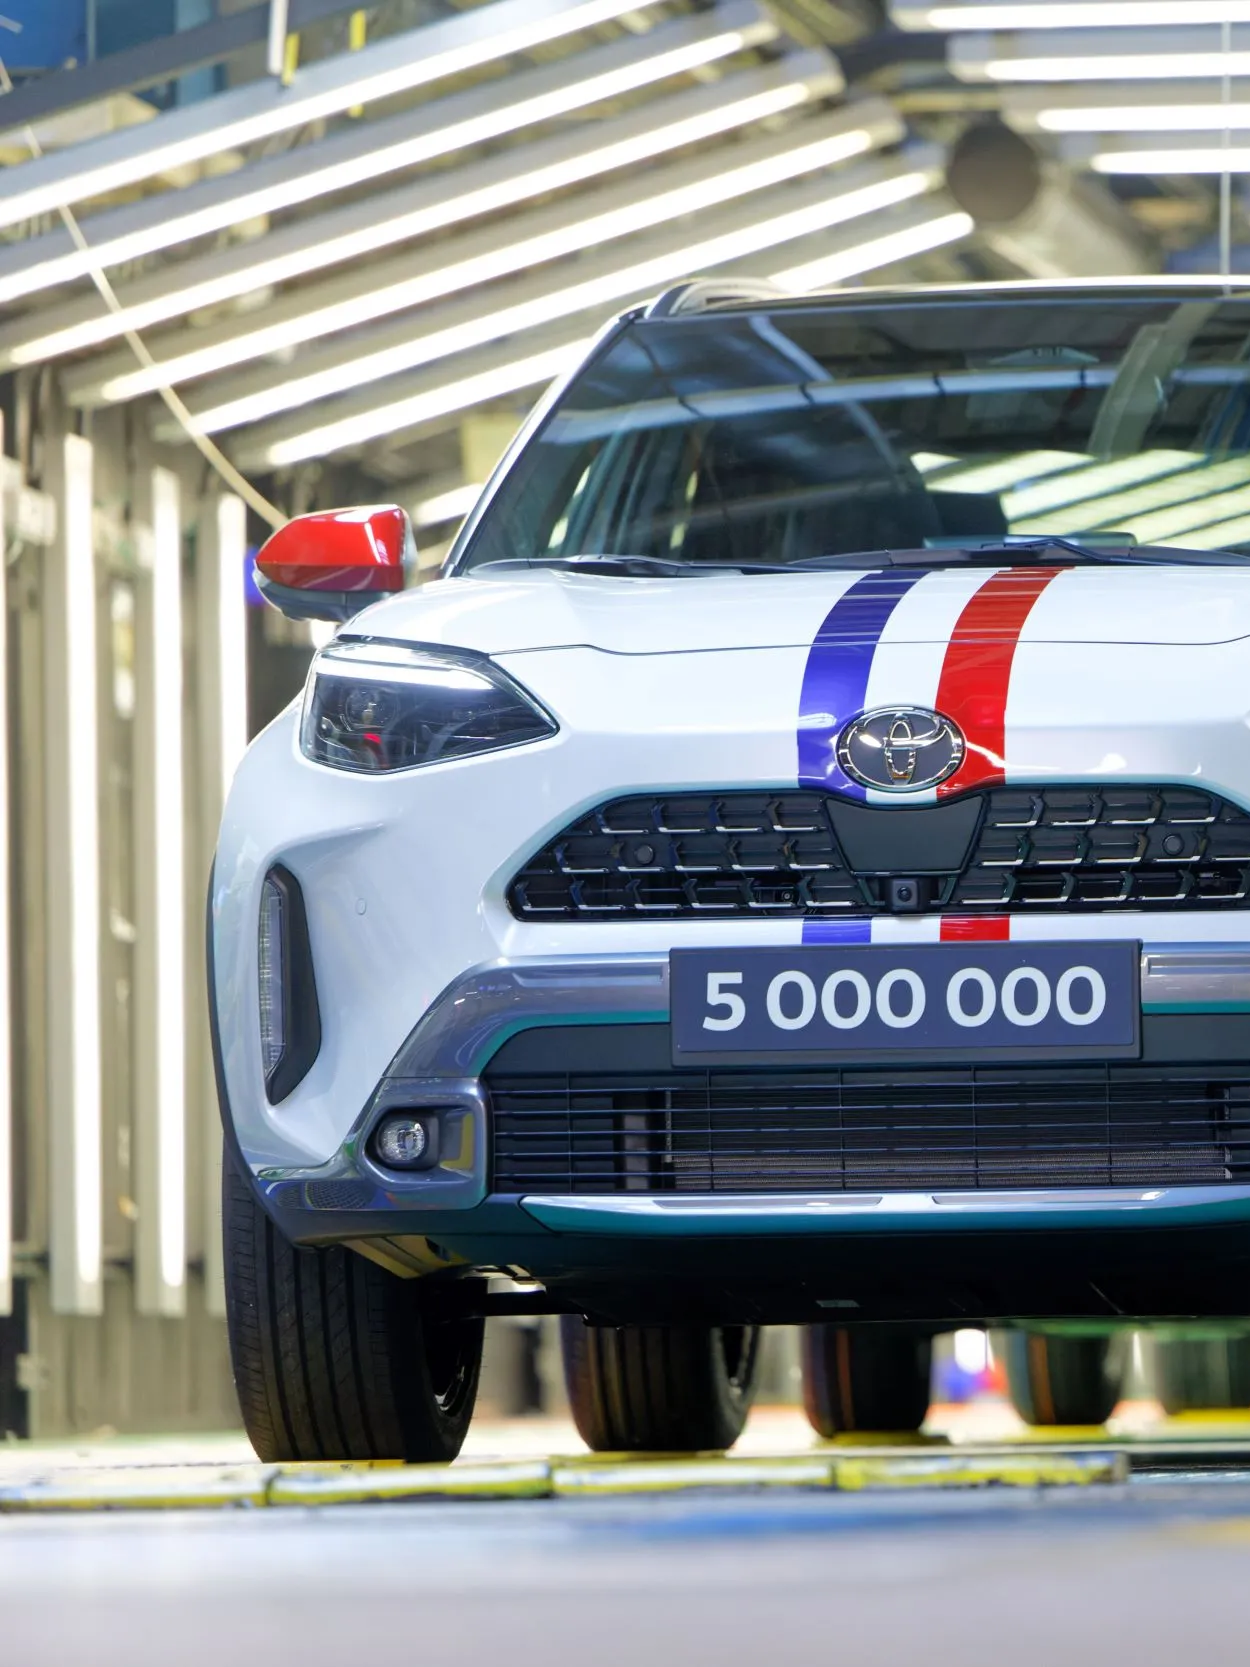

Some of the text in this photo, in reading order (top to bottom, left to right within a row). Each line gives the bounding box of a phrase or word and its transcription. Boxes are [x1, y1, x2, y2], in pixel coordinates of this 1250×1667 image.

[702, 965, 1106, 1032] 5 000 000
